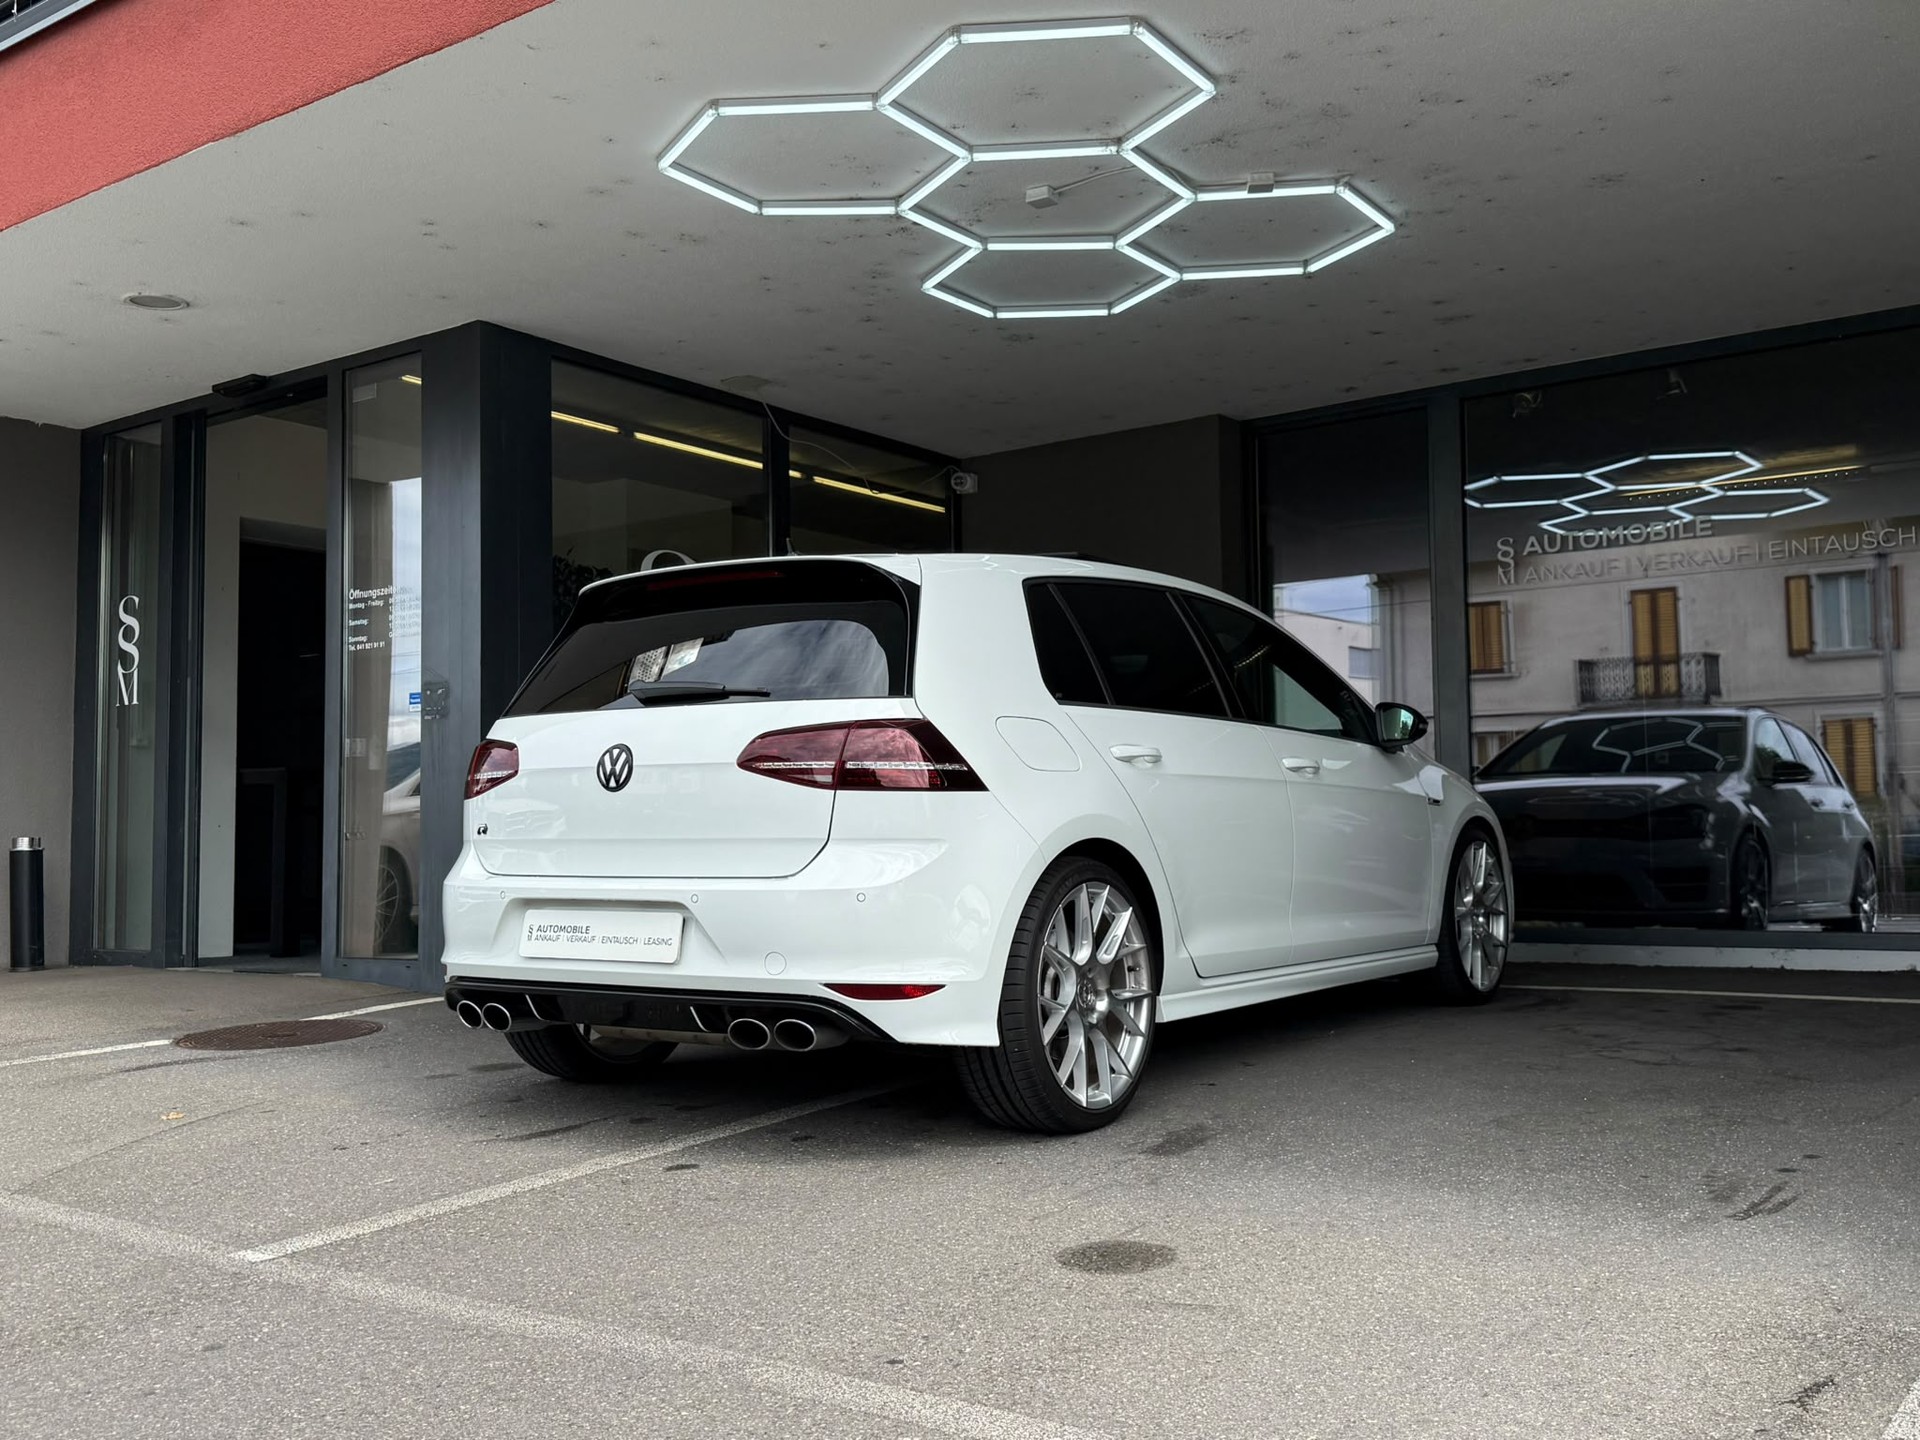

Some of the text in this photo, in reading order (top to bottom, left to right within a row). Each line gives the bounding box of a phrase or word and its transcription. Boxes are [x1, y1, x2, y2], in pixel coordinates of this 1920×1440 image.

[1522, 515, 1713, 556] AUTOMOBILE
[1523, 525, 1917, 585] ANKAUF VERKAUF EINTAUSCH
[534, 934, 673, 946] ANKAUF VERKAUF EINTAUSCH LEASING
[536, 924, 591, 935] AUTOMOBILE
